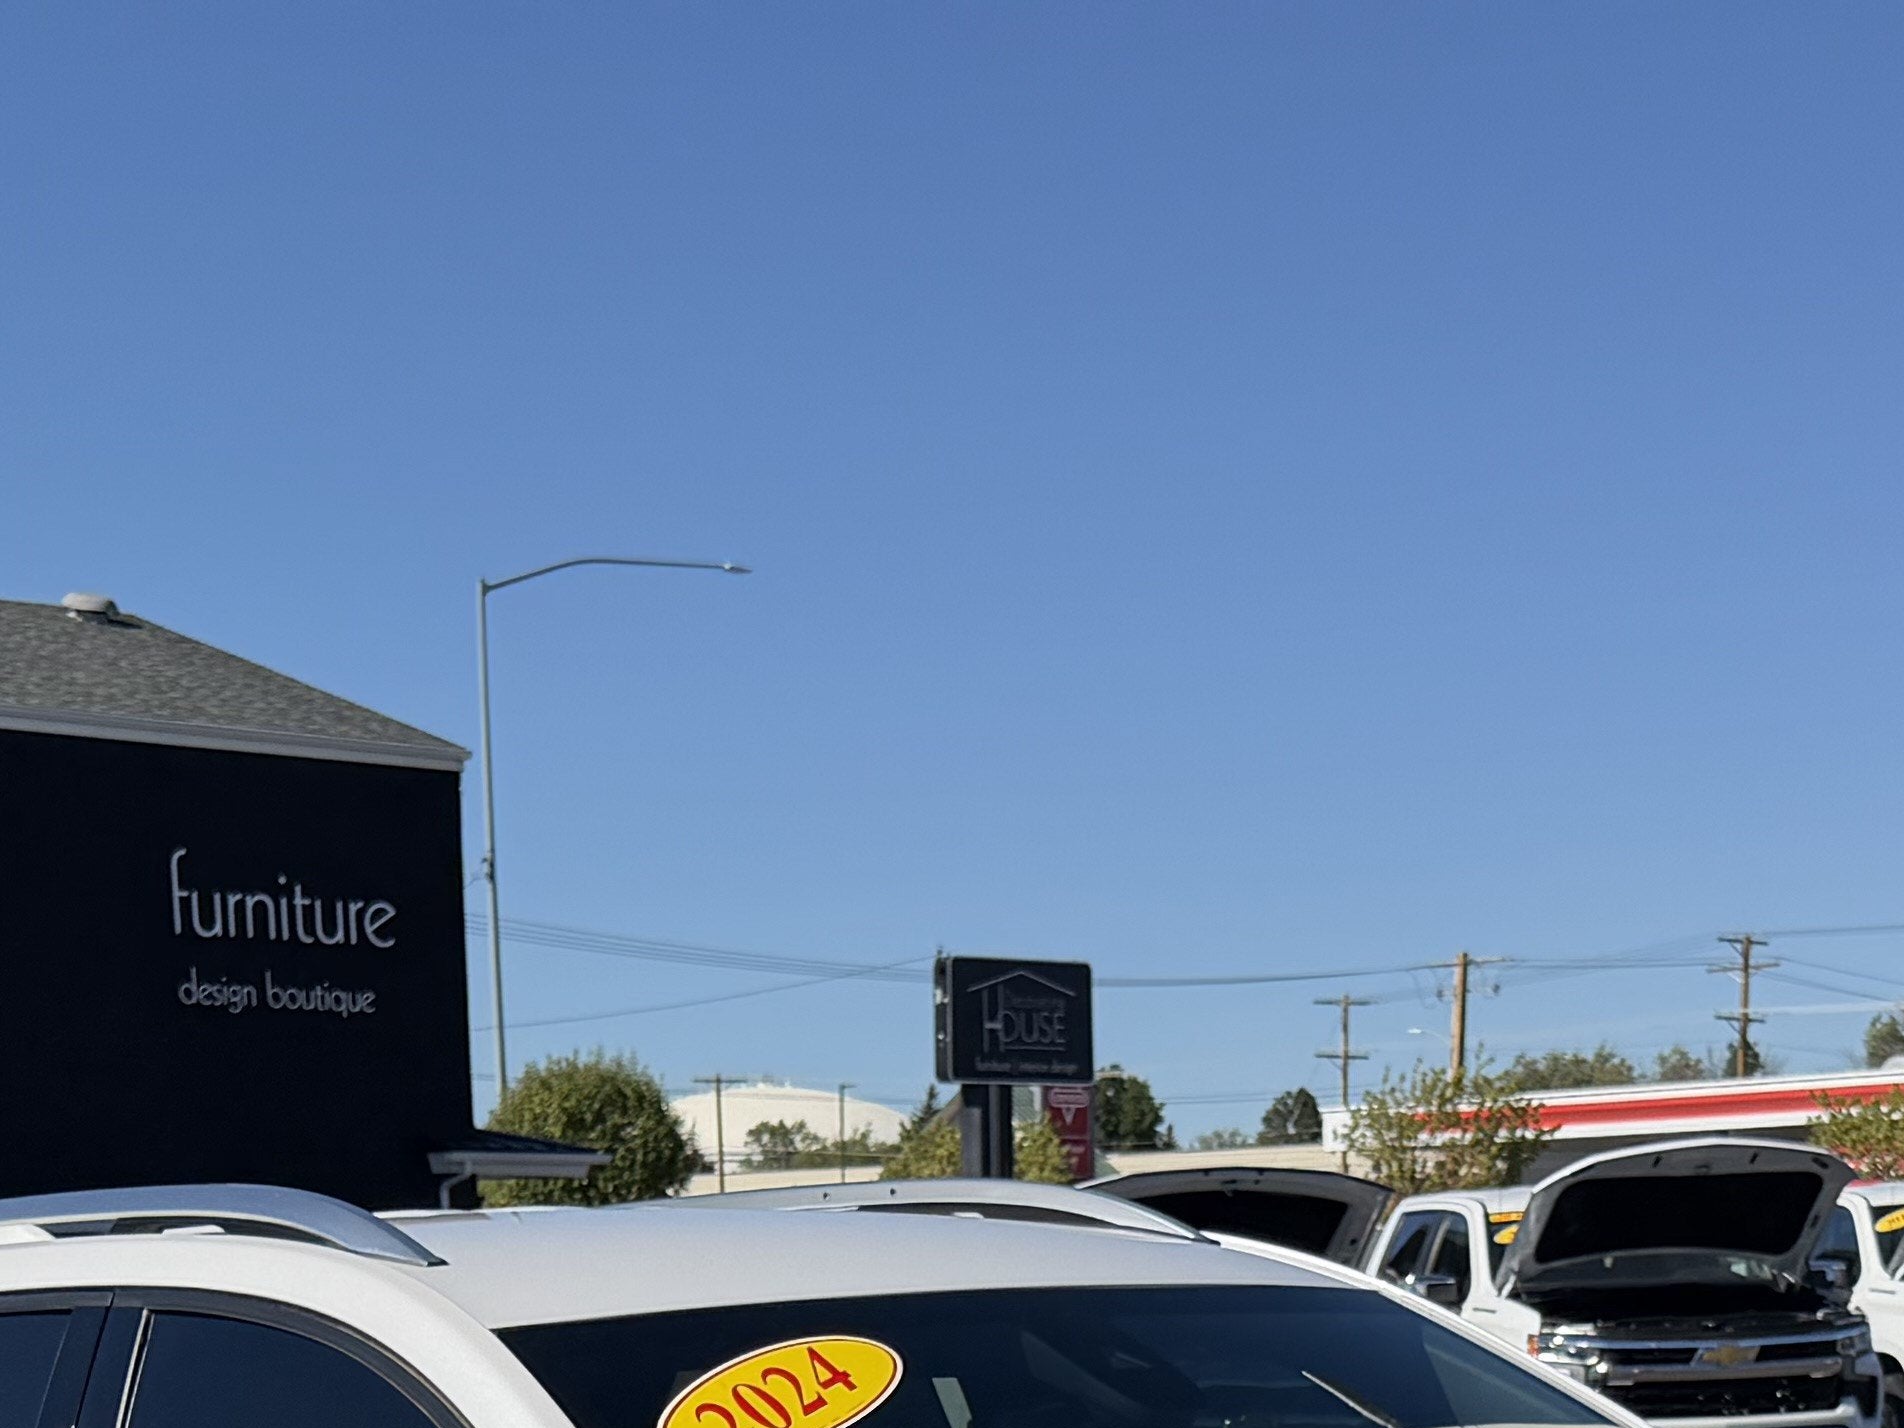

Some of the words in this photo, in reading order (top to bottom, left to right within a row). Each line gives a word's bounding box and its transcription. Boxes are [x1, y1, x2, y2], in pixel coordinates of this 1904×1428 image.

[170, 848, 396, 948] furniture
[178, 967, 257, 1014] design
[264, 969, 376, 1018] boutique
